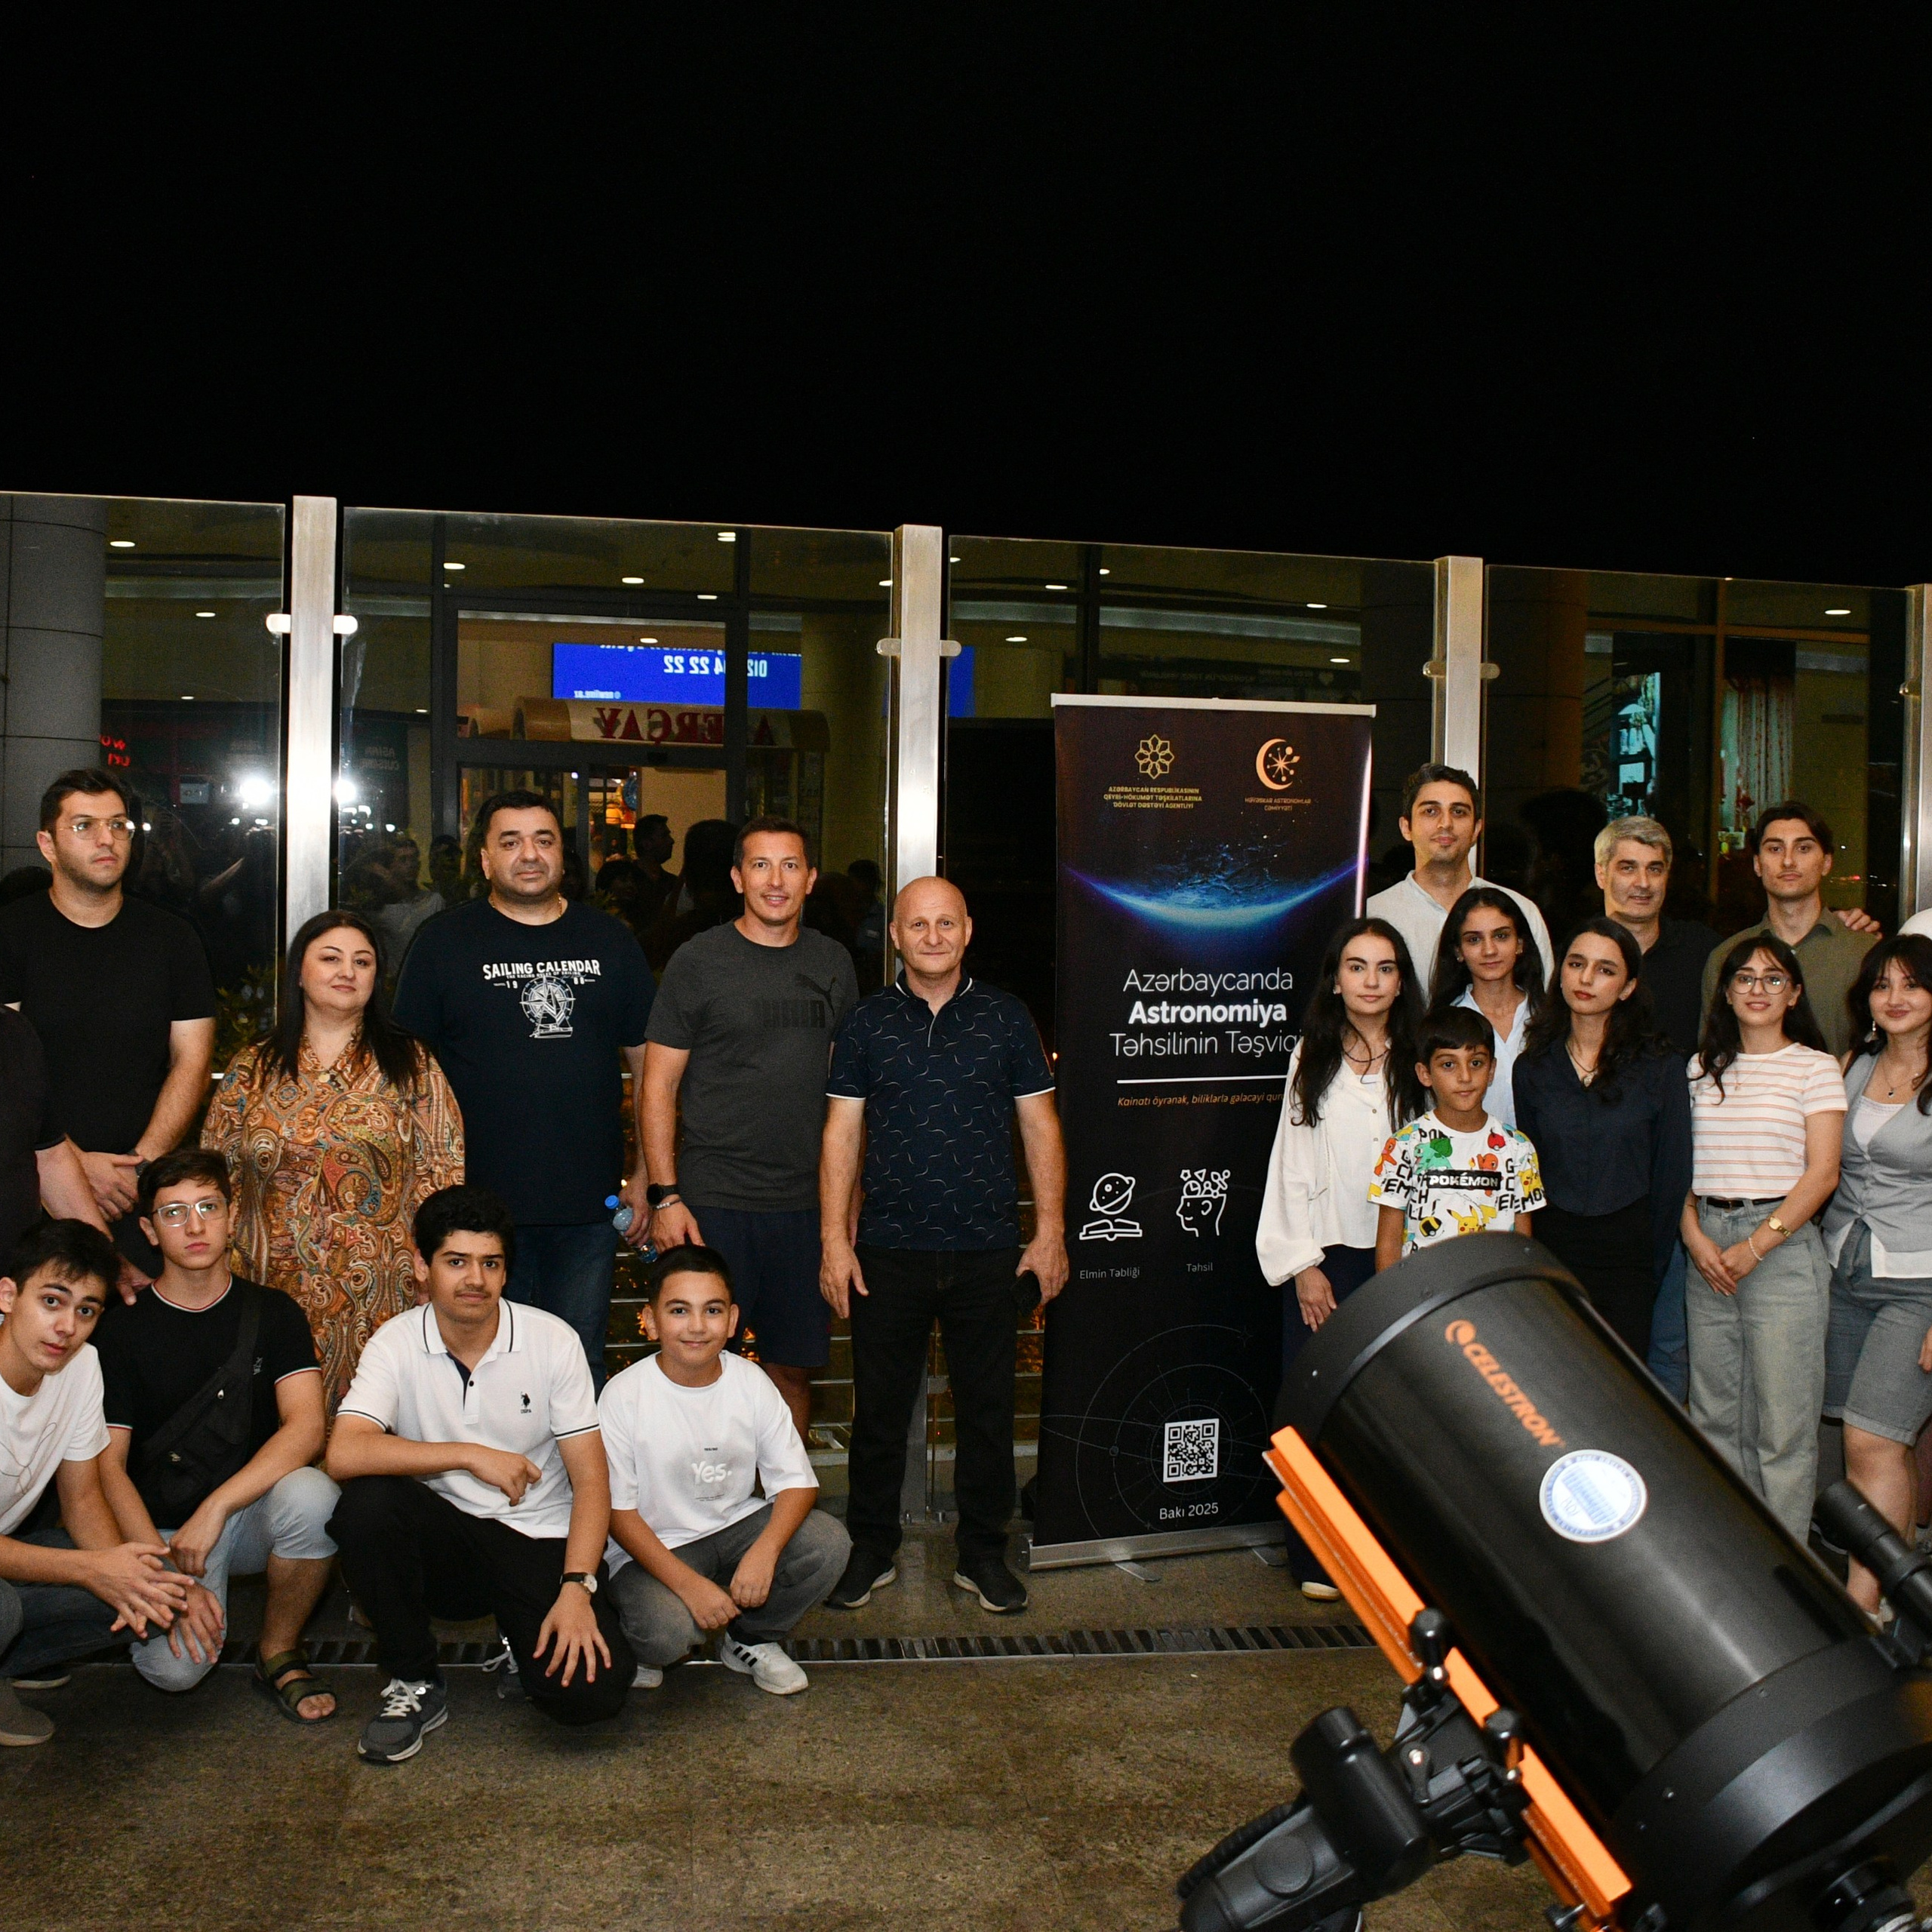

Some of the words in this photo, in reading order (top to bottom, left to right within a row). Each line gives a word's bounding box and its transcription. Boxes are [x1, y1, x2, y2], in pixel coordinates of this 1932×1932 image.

[483, 962, 534, 980] SAILING
[536, 959, 601, 976] CALENDAR
[1122, 967, 1294, 997] Azərbaycanda
[1128, 998, 1287, 1028] Astronomiya
[1109, 1031, 1218, 1057] Təhsilinin
[1429, 1172, 1499, 1187] POKÉMON
[1079, 1269, 1106, 1279] Elmin
[1109, 1266, 1140, 1278] Təbliği
[1186, 1262, 1214, 1272] Təhsil
[1463, 1342, 1562, 1447] CELESTRON
[691, 1460, 732, 1485] Yes.
[1159, 1506, 1185, 1520] Bakı
[1188, 1502, 1219, 1517] 2025
